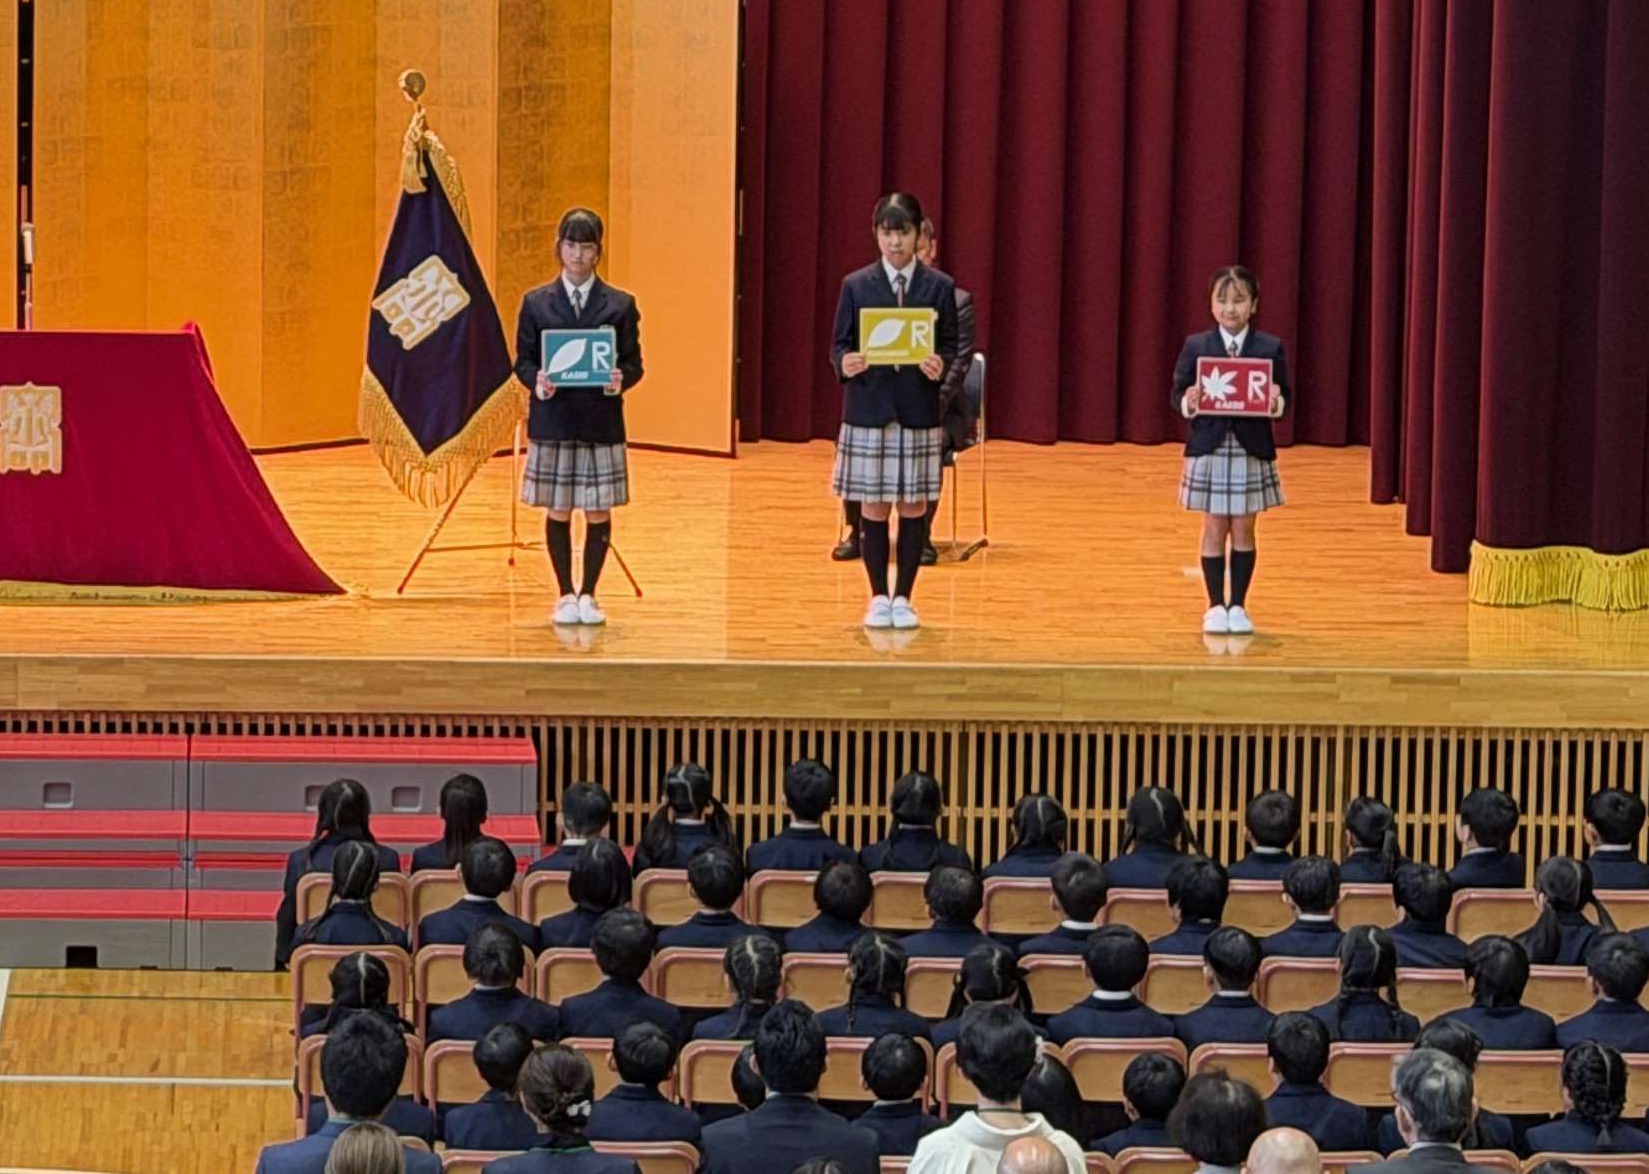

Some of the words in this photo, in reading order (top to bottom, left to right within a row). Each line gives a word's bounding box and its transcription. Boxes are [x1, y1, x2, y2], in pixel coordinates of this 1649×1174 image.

[911, 320, 930, 349] R
[592, 341, 611, 370] R
[1247, 370, 1267, 401] R
